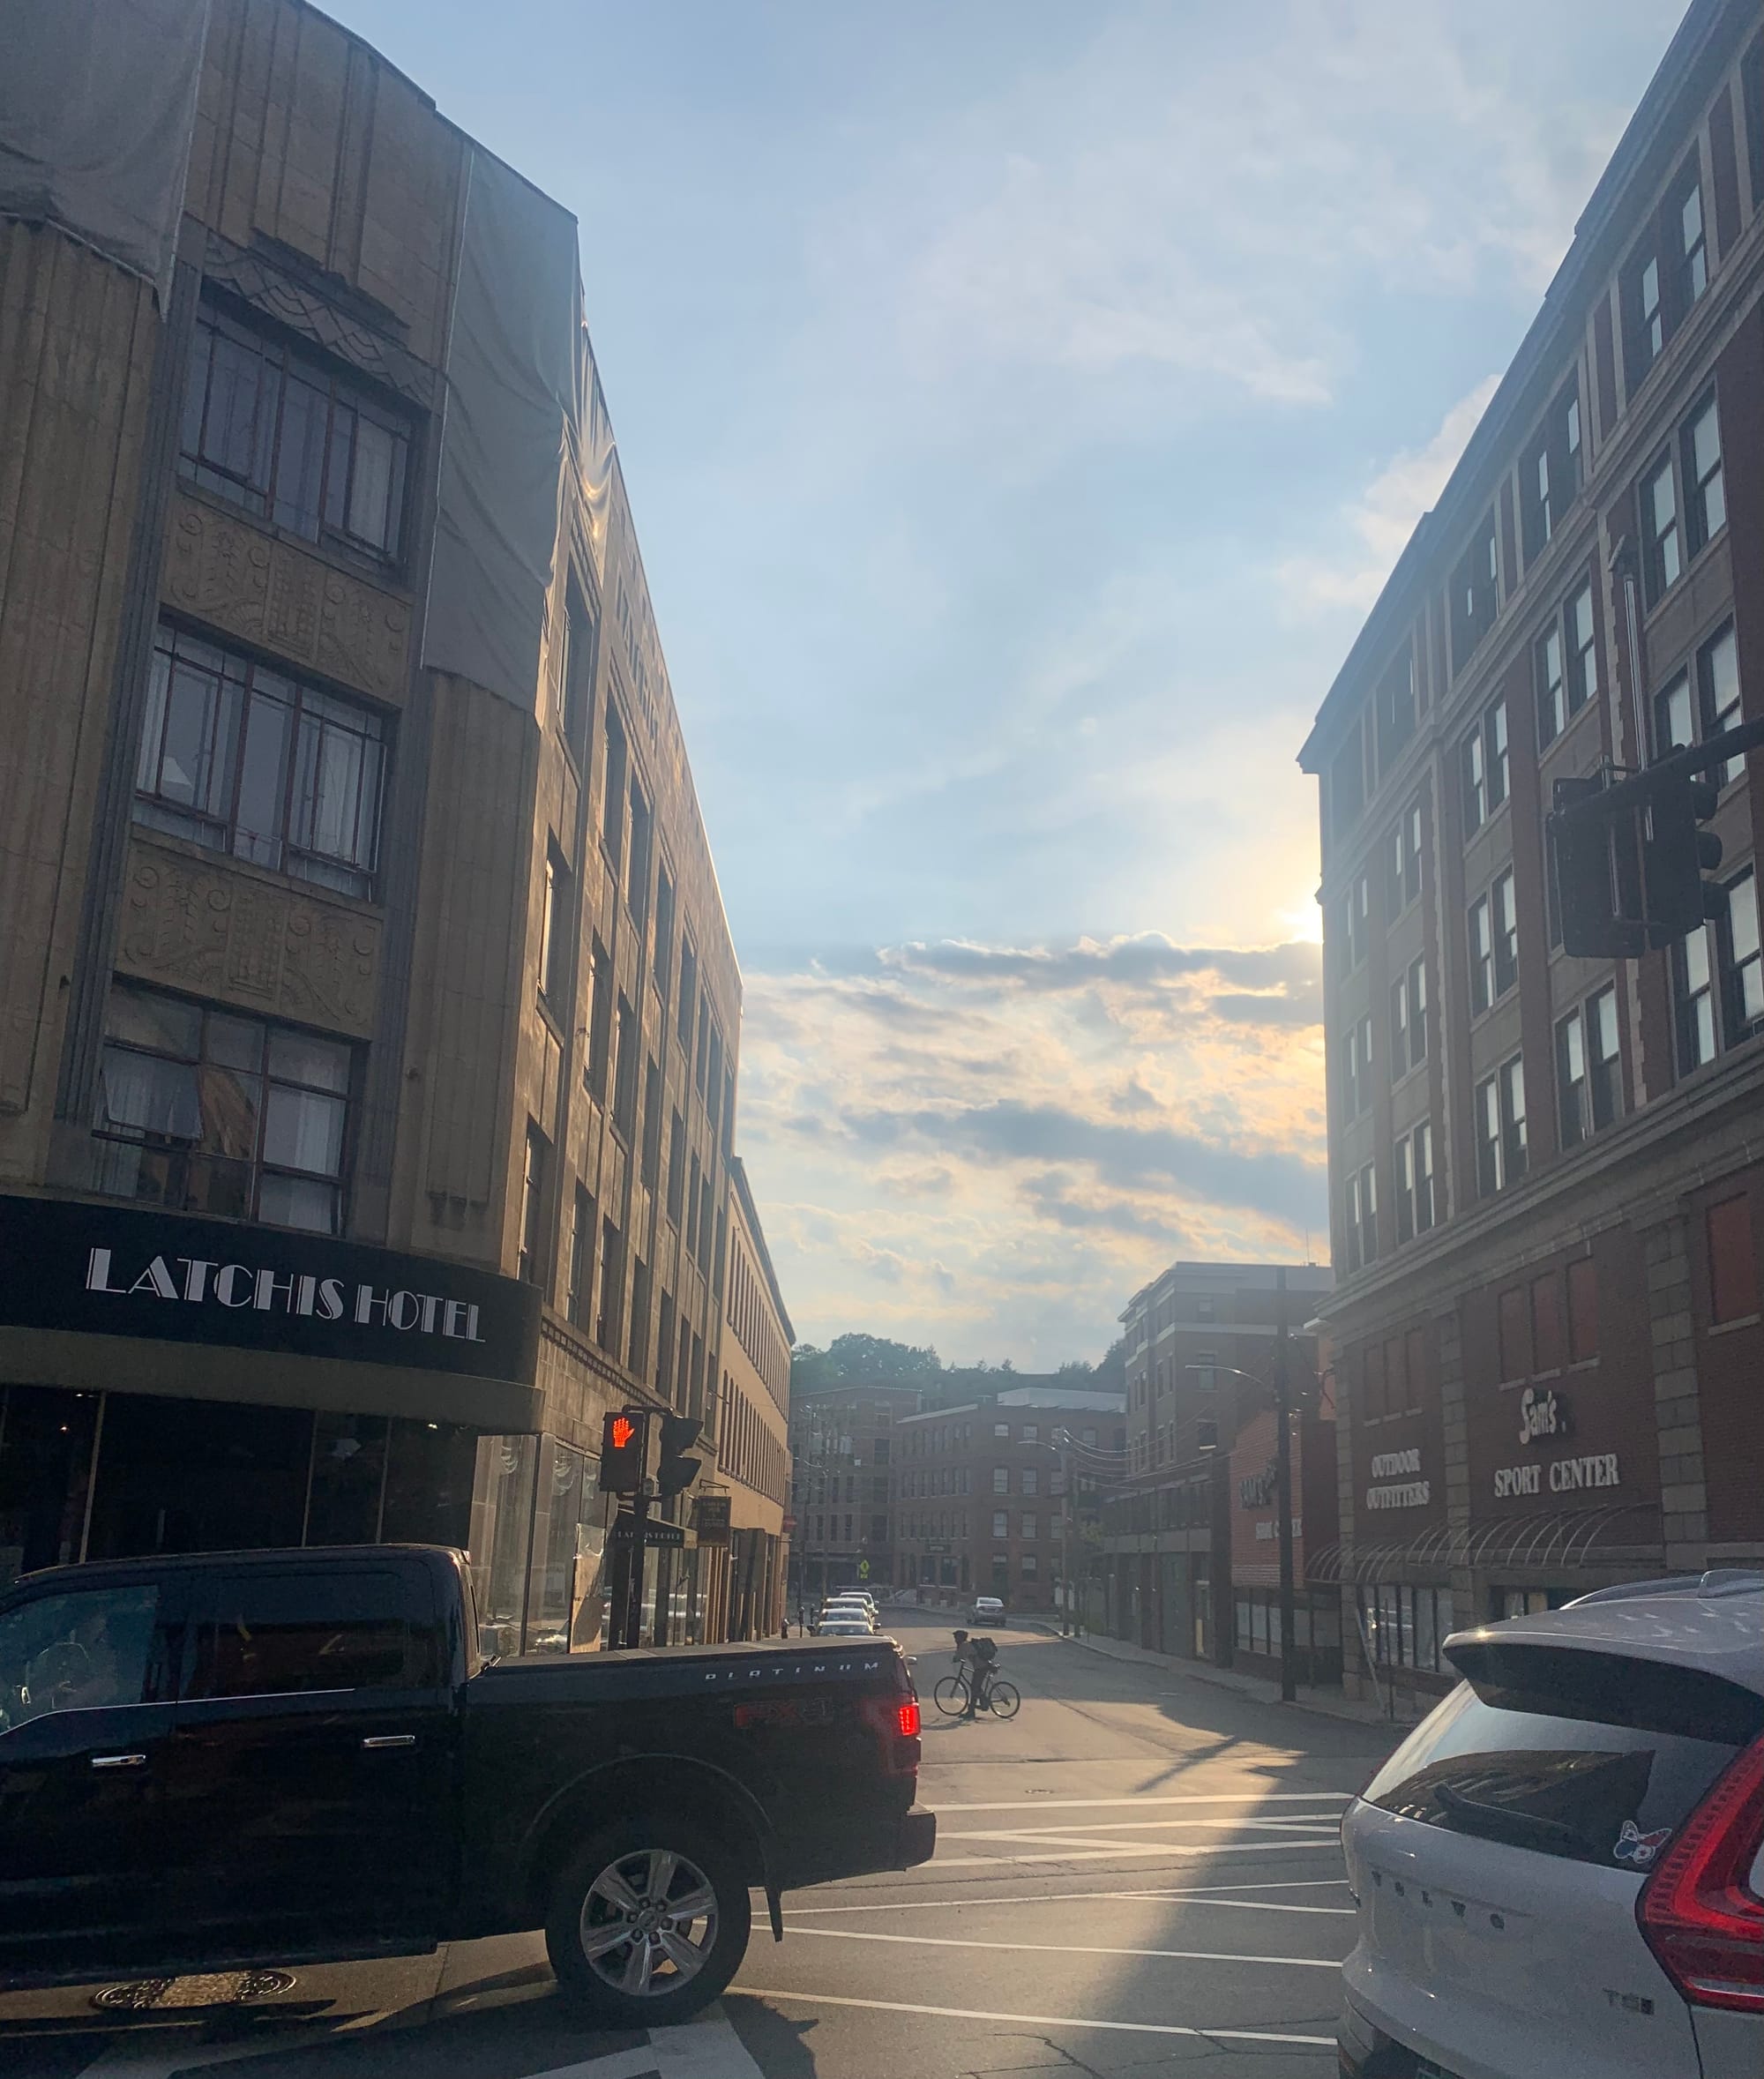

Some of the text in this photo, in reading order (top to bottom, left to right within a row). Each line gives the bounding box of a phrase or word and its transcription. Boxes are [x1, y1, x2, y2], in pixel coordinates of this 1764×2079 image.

[86, 1247, 486, 1342] LATCHIS HOTEL
[1372, 1448, 1421, 1478] OUTDOOR
[1495, 1454, 1620, 1497] SPORT CENTER
[1366, 1481, 1430, 1510] OUTFITTERS
[705, 1661, 880, 1680] PLATINUM
[1372, 1870, 1505, 1930] VOLVO
